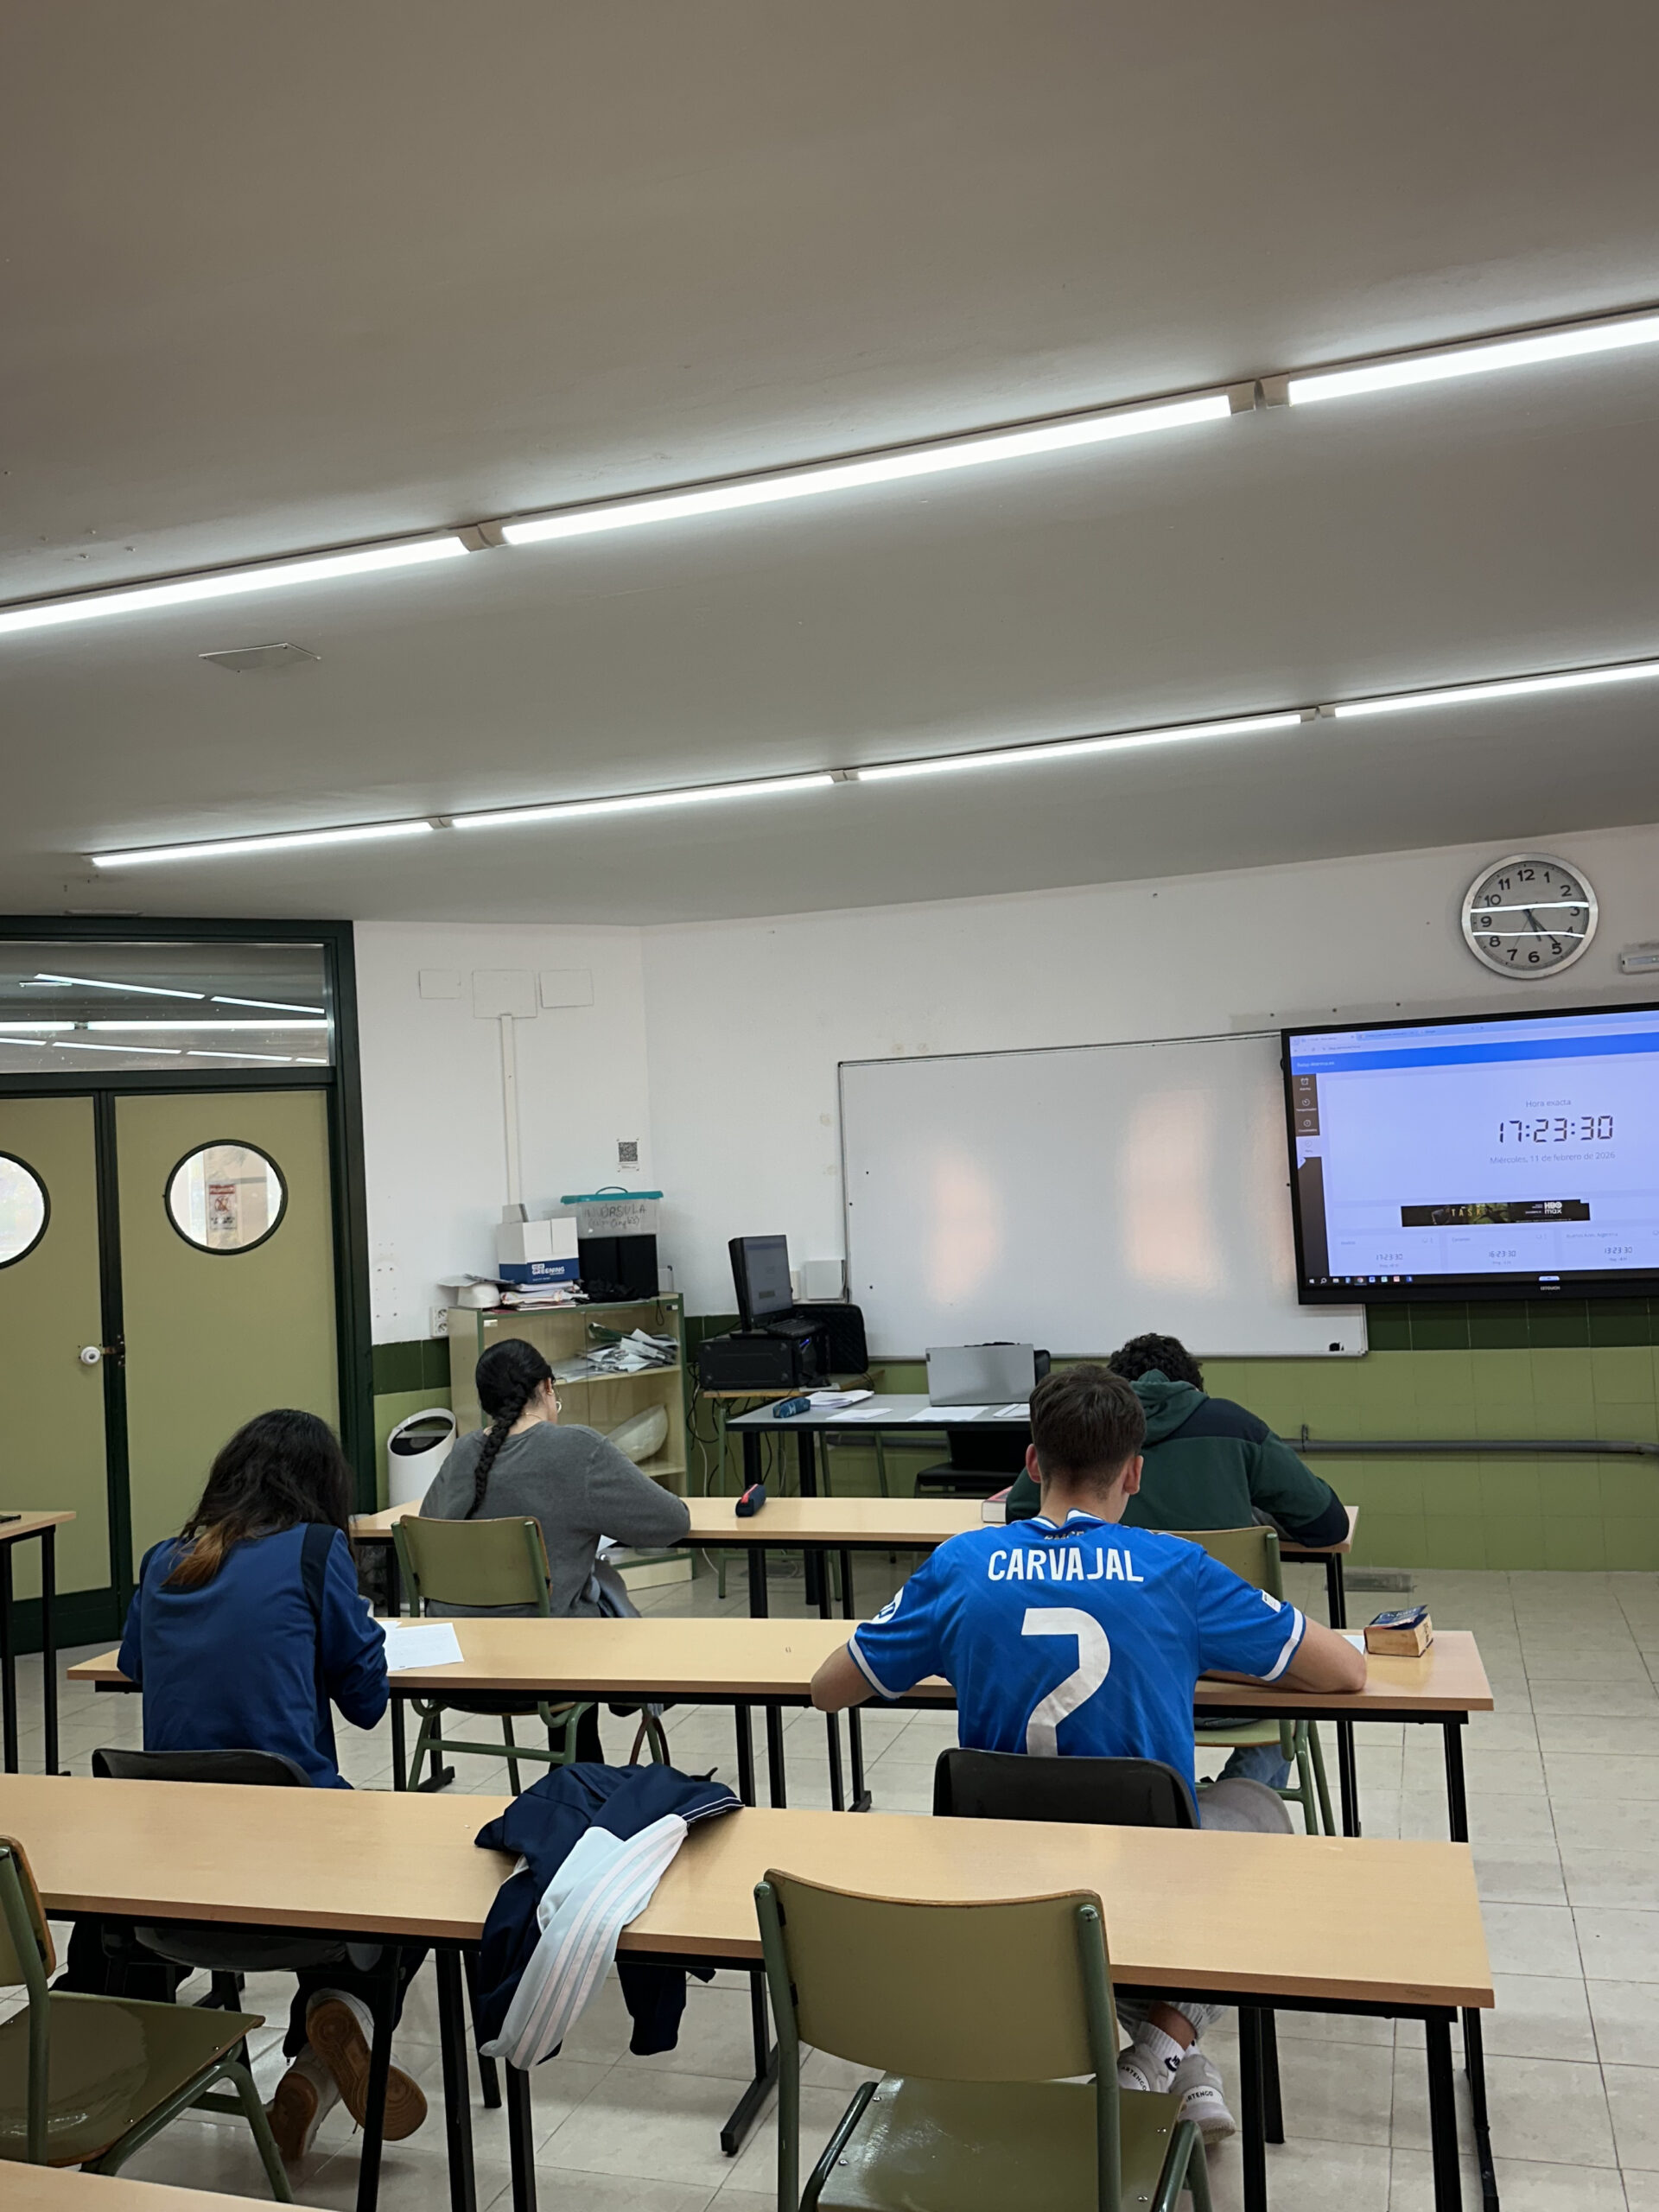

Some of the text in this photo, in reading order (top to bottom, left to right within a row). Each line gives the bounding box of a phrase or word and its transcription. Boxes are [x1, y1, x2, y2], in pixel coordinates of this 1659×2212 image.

[1517, 868, 1535, 881] 12
[1543, 871, 1551, 883] 1
[1498, 878, 1510, 890] 11
[1560, 885, 1572, 897] 2
[1484, 893, 1502, 906] 10
[1570, 906, 1580, 917] 3
[1480, 916, 1492, 927] 9
[1489, 936, 1501, 947] 8
[1506, 949, 1518, 961] 7
[1551, 943, 1562, 955] 5
[1528, 951, 1540, 963] 6
[1499, 1116, 1613, 1143] 17:23:30
[1596, 1151, 1616, 1160] 2026
[1544, 1201, 1562, 1210] HBO
[988, 1547, 1144, 1583] CARVAJAL
[1020, 1607, 1111, 1758] 2
